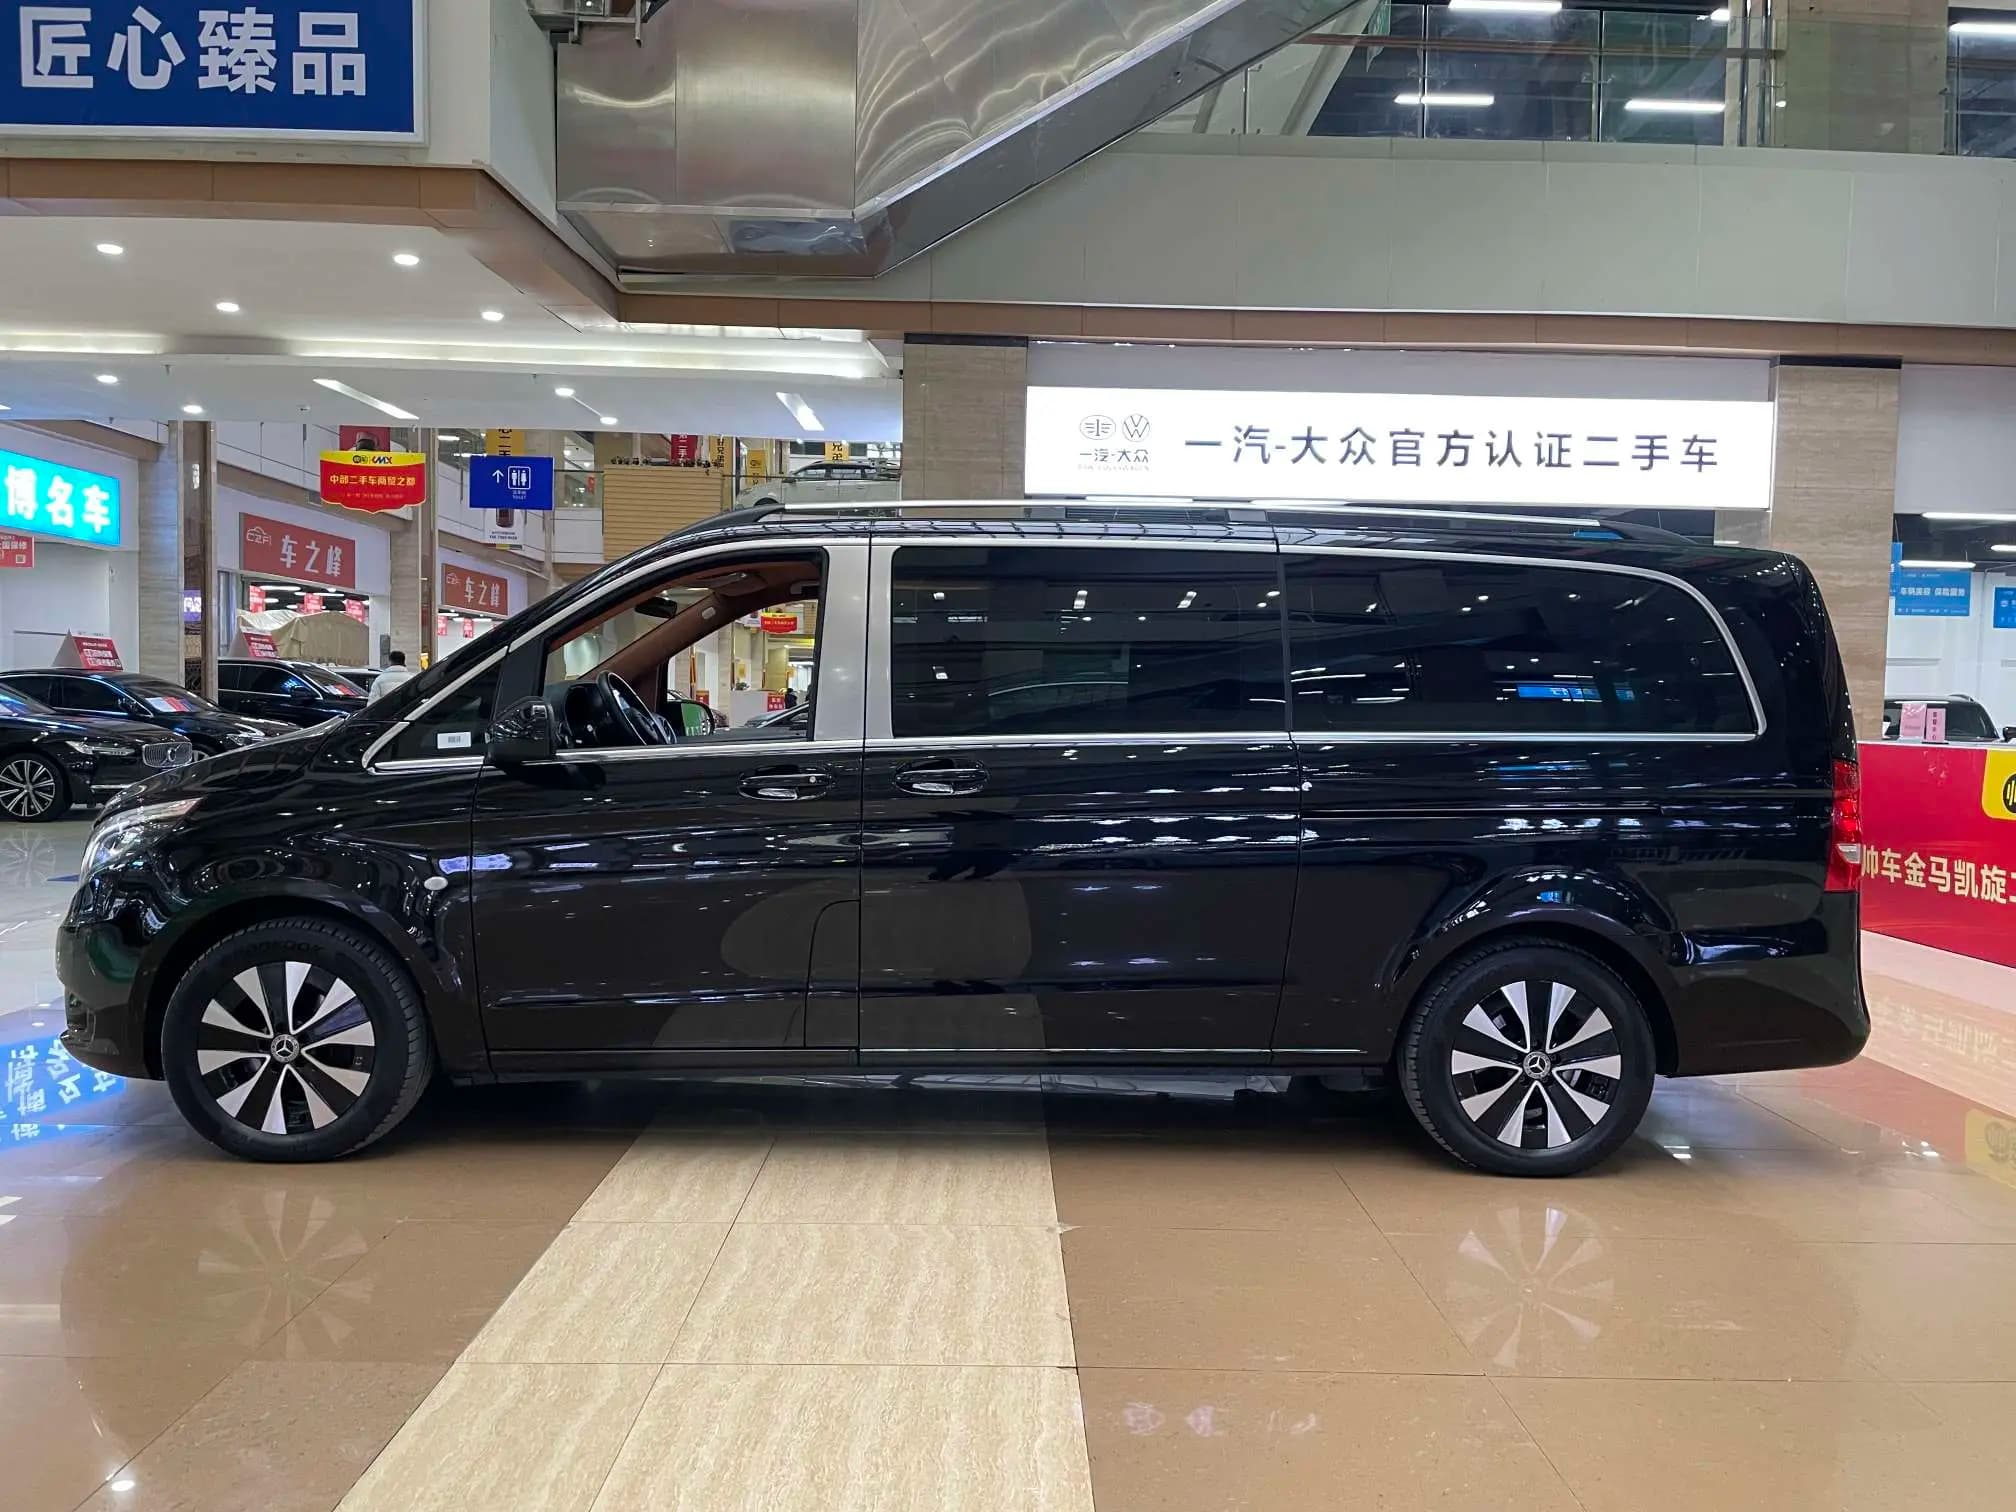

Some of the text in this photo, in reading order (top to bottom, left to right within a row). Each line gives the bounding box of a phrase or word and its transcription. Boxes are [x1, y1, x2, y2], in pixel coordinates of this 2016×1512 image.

[19, 5, 367, 96] 匠心臻品
[1184, 424, 1718, 473] 一汽-大众官方认证二手车
[279, 535, 343, 577] 车之峰
